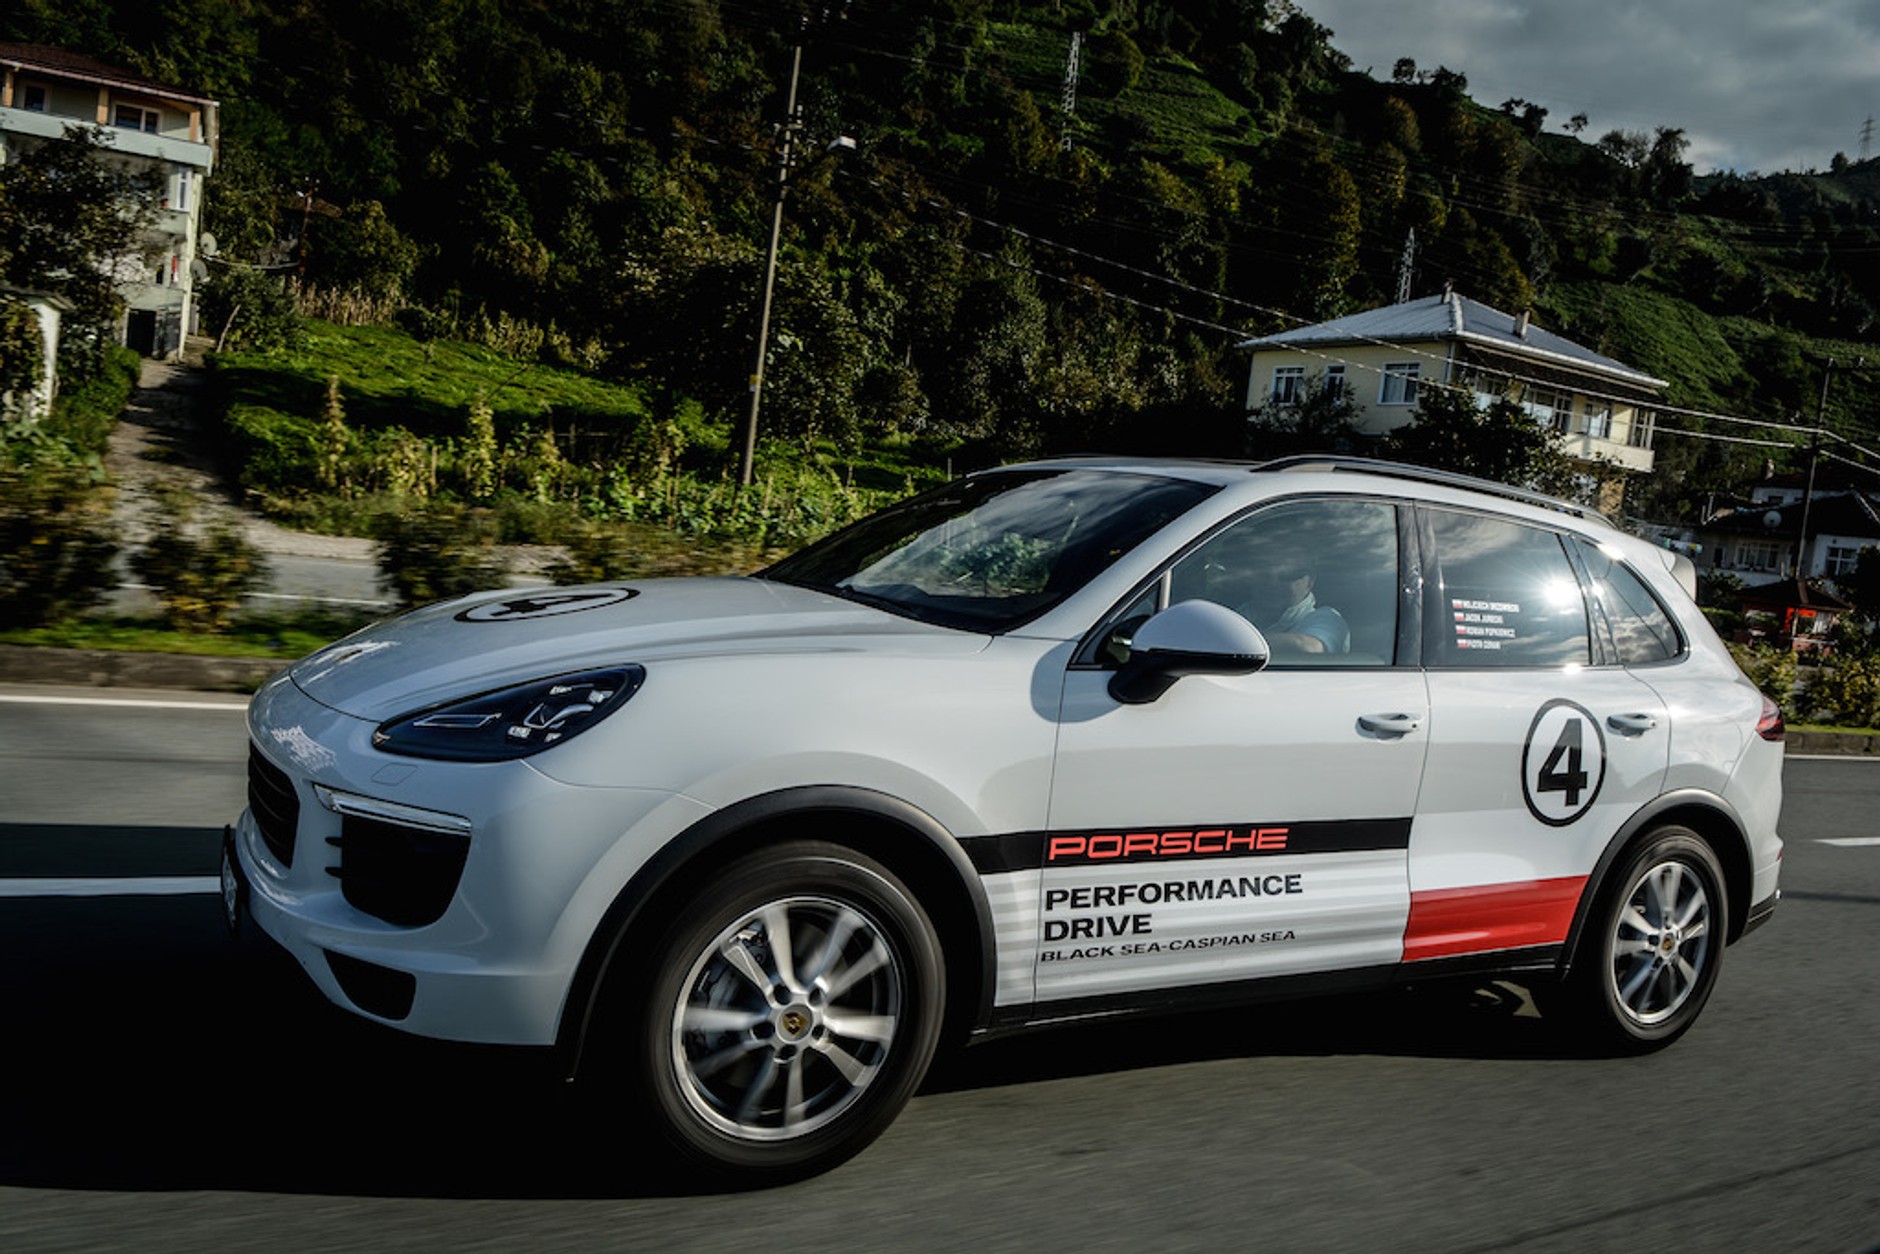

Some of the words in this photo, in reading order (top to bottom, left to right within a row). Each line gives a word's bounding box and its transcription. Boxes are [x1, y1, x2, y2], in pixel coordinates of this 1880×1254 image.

[1537, 718, 1588, 807] 4
[1049, 828, 1289, 861] PORSCHE
[1045, 874, 1303, 911] PERFORMANCE
[1044, 914, 1153, 942] DRIVE
[1041, 945, 1115, 962] BLACK
[1121, 933, 1256, 956] SEA-CASPIAN
[1260, 930, 1296, 943] SEA
